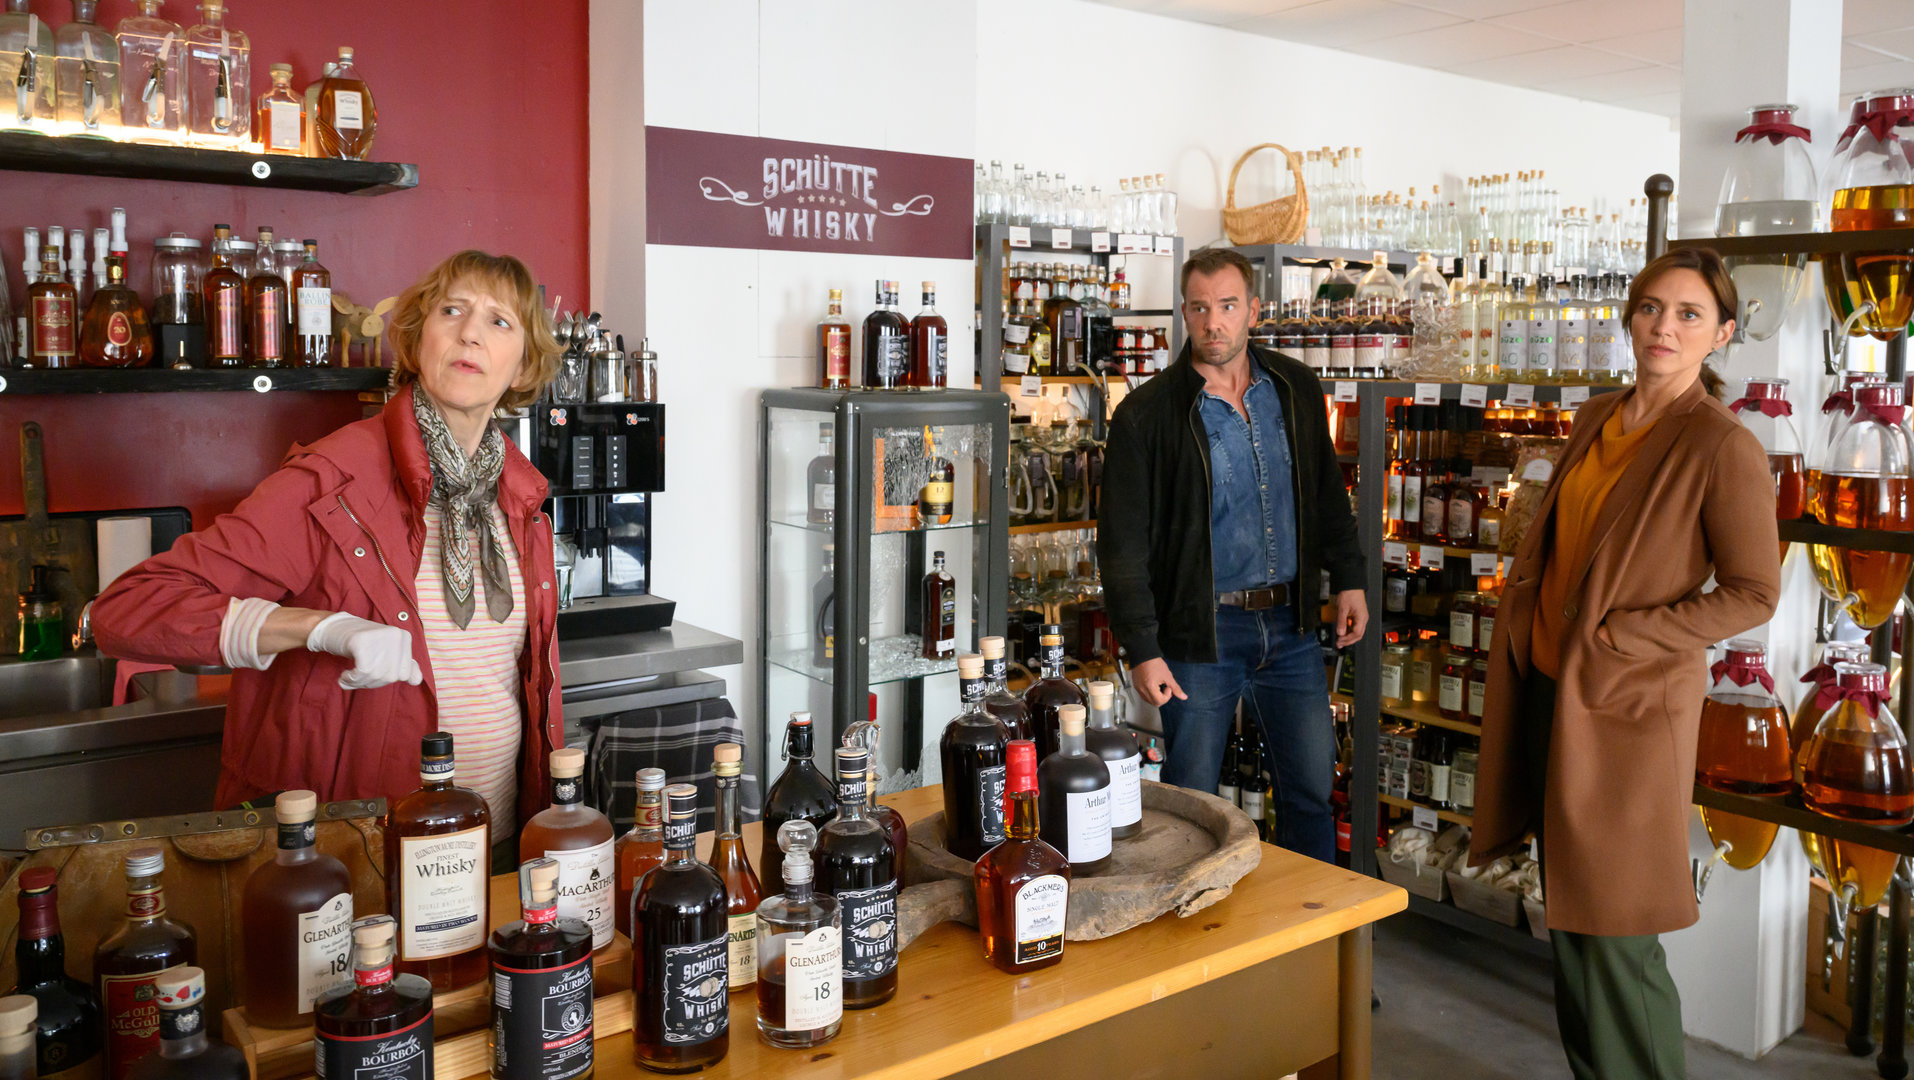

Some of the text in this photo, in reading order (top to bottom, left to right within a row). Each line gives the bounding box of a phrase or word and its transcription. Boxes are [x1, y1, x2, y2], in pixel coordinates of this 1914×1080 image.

[763, 154, 878, 210] SCHÜTTE
[764, 206, 877, 242] WHISKY
[1085, 795, 1107, 809] Arthur
[416, 858, 477, 878] Whisky
[587, 906, 601, 922] 25
[853, 898, 895, 924] SCHÜTTE
[303, 917, 353, 944] GLENARTH
[727, 927, 757, 943] ENARTH
[854, 932, 896, 958] WHISKY
[1037, 941, 1047, 951] 10
[324, 952, 347, 976] 18
[683, 951, 727, 982] SCHÜTTE
[739, 955, 751, 967] 18
[549, 972, 592, 995] BOURBON
[814, 981, 831, 1001] 18
[132, 1006, 157, 1018] OLD
[684, 988, 727, 1020] WHISKY
[362, 1041, 421, 1067] BOURBON
[372, 1034, 419, 1055] Kentucky
